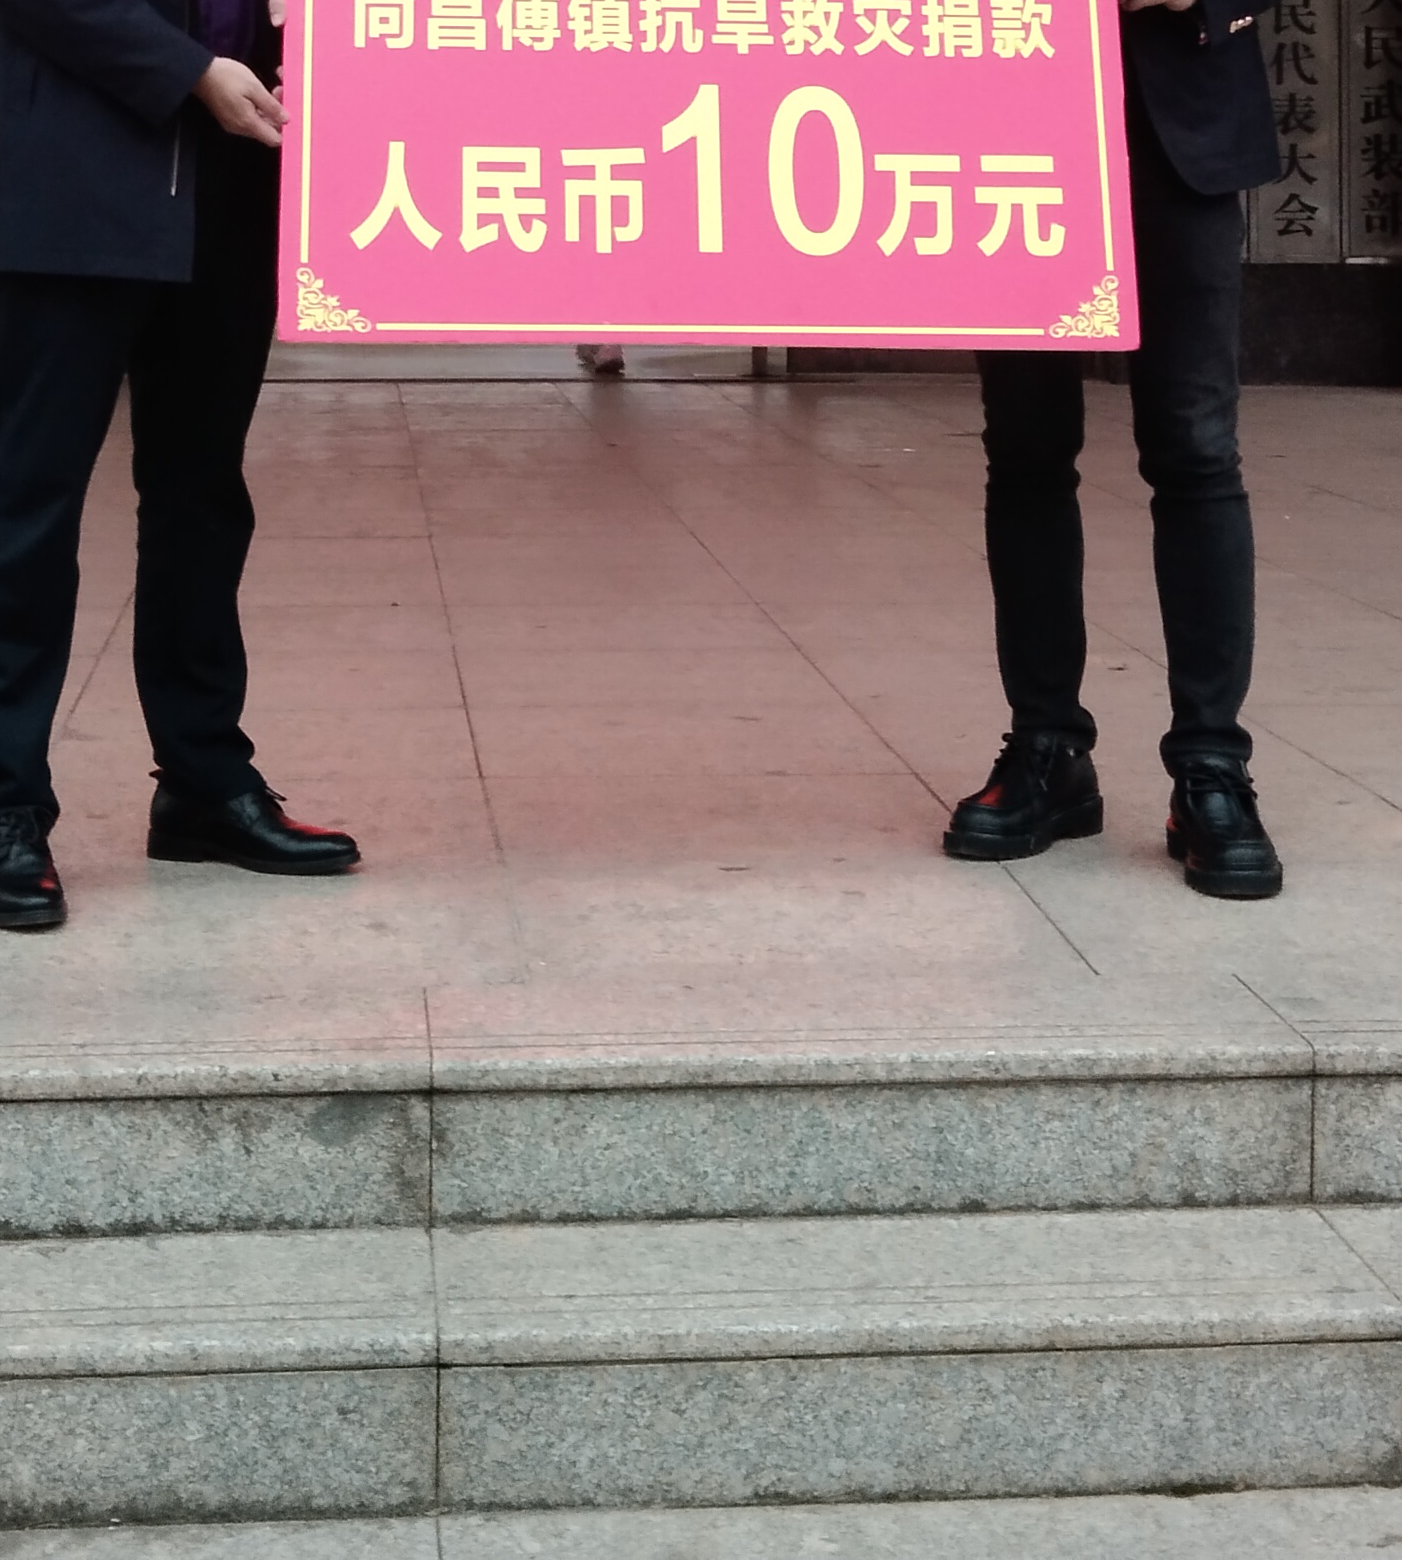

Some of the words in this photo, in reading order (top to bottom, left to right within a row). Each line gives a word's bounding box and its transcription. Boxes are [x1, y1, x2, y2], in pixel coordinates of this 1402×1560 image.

[350, 85, 1065, 256] 人民币10万元
